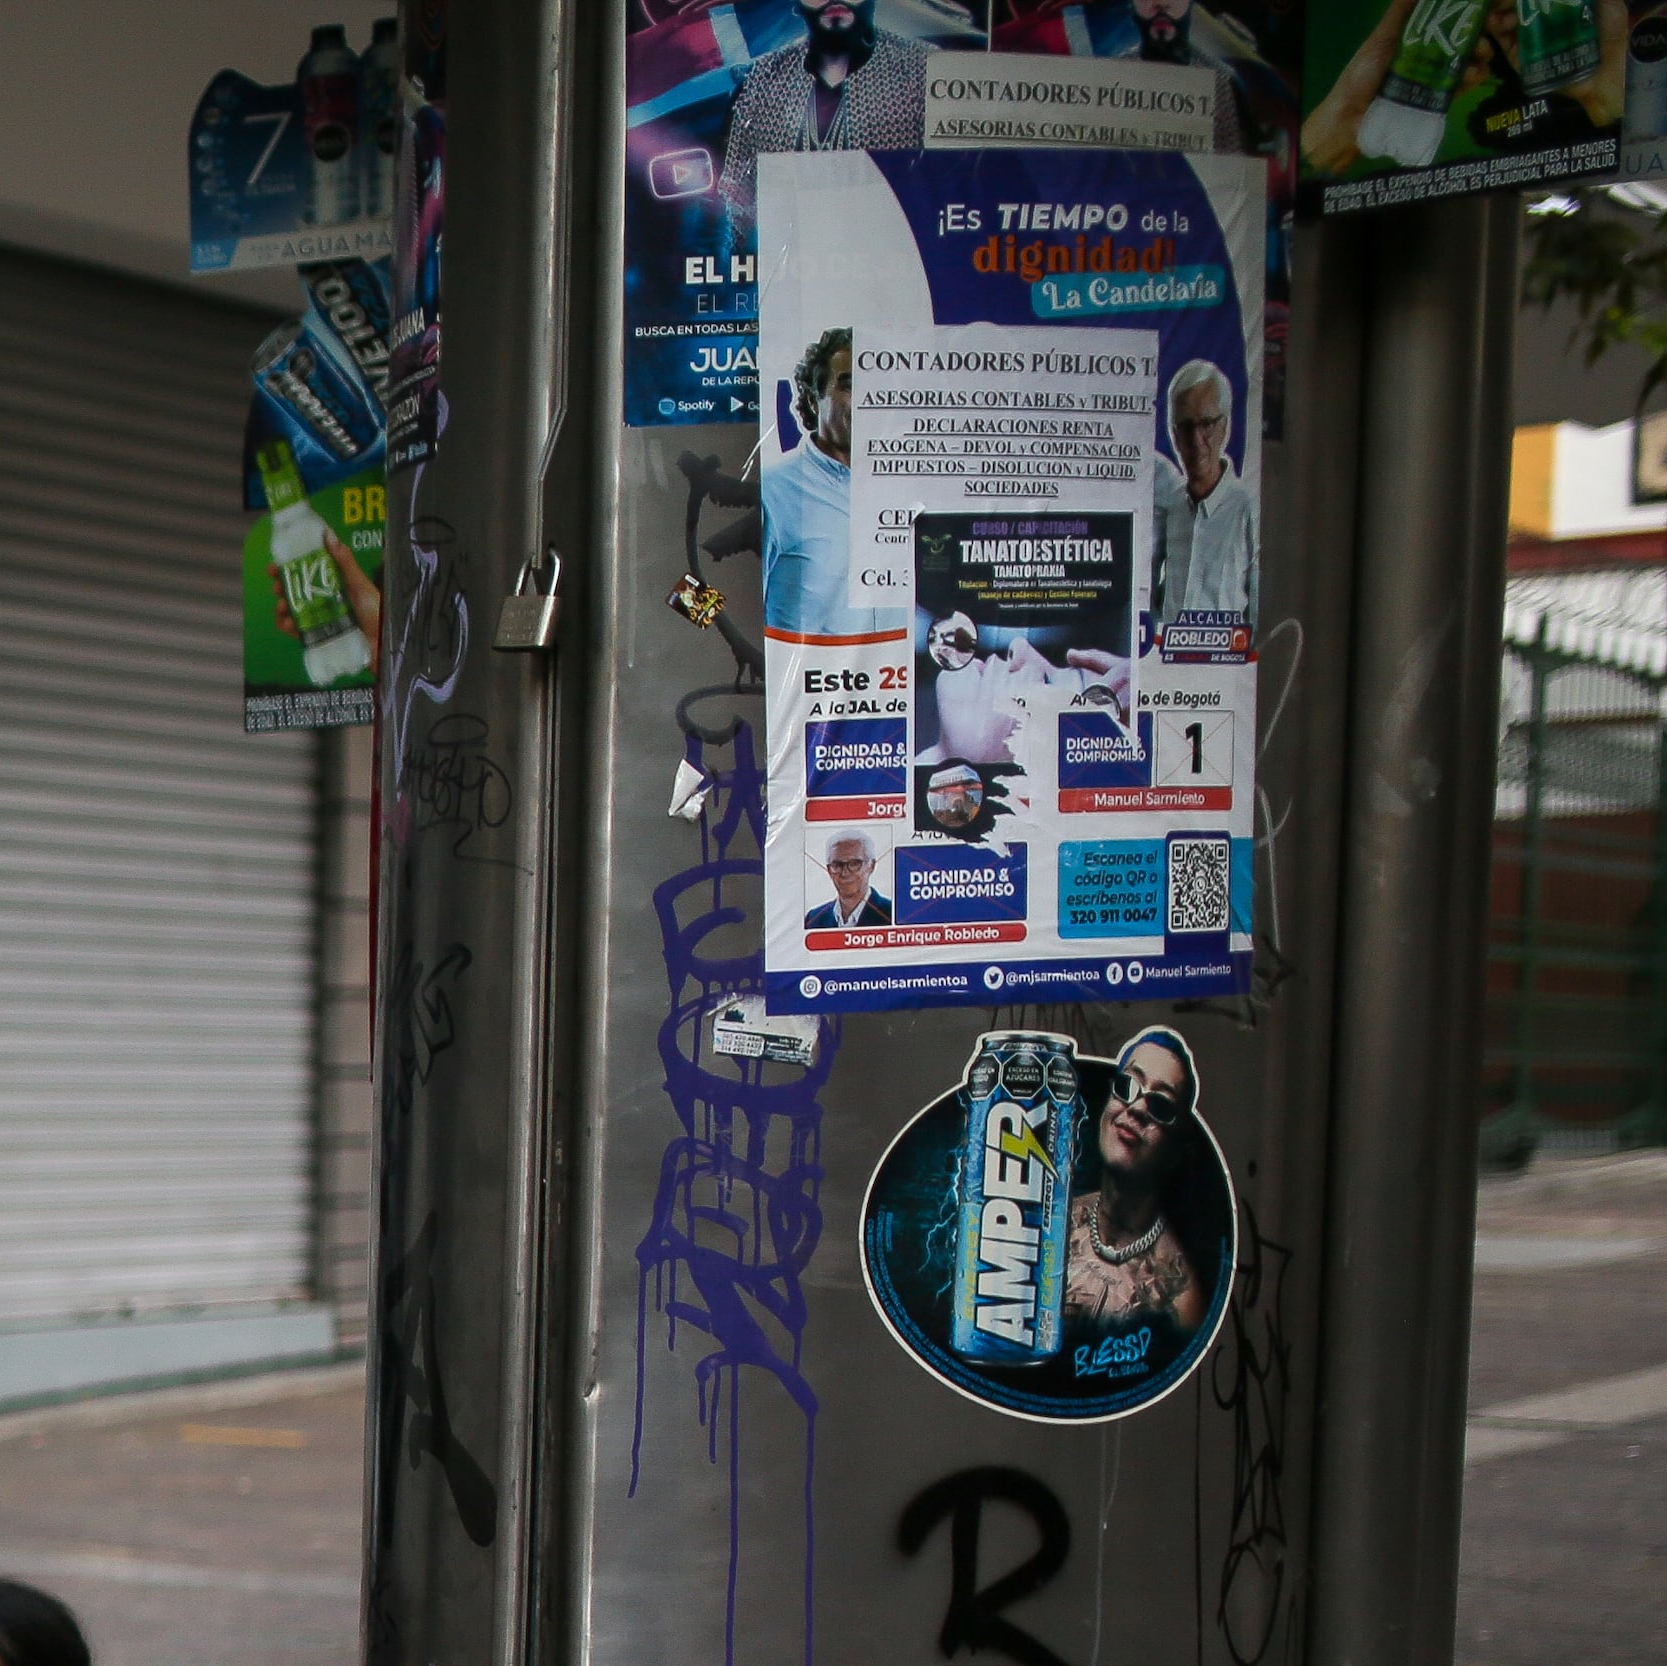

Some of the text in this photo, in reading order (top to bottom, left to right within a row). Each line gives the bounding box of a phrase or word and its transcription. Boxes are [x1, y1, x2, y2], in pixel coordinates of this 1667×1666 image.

[930, 79, 1091, 105] CONTADORES
[1097, 81, 1195, 115] PÚBLICOS
[1486, 100, 1548, 133] NUEVA LATA
[934, 120, 1037, 138] ASESORIAS
[1039, 122, 1140, 147] CONTABLES
[244, 112, 293, 184] 7
[1489, 149, 1561, 173] EMBRIAGANTES
[1562, 147, 1569, 161] A
[1571, 139, 1616, 158] MENORES
[1428, 180, 1467, 197] ALCOHOL
[1470, 177, 1482, 191] ES
[1484, 166, 1542, 188] PERJUDICIAL
[1544, 161, 1568, 178] PARA
[1571, 157, 1582, 172] LA
[1584, 152, 1617, 171] SALUD.
[938, 204, 1189, 236] ¡Es TIEMPO de la
[282, 232, 350, 258] AGUA
[686, 256, 723, 285] EL
[697, 293, 723, 314] EL
[1041, 281, 1083, 311] La
[635, 326, 675, 337] BUSCA
[677, 325, 693, 335] EN
[694, 323, 734, 335] TODAS
[857, 351, 1025, 373] CONTADORES
[1031, 348, 1136, 376] PÚBLICOS
[702, 377, 715, 386] DE
[718, 377, 732, 385] LA
[678, 399, 714, 413] Spotify
[862, 391, 968, 406] ASESORIAS
[971, 391, 1075, 408] CONTABLES
[1091, 394, 1152, 411] TRIBUT.
[913, 418, 1113, 437] DECLARACIONES RENTA
[868, 440, 947, 454] EXOGENA
[963, 441, 1016, 455] DEVOL
[1031, 441, 1141, 459] COMPENSACION
[873, 459, 966, 474] IMPUESTOS
[981, 460, 1072, 476] DISOLUCION
[1086, 463, 1136, 479] LIQUID.
[964, 480, 1059, 495] SOCIEDADES
[973, 521, 1008, 535] CURSO
[959, 535, 1114, 563] TANATOESTÉTICA
[861, 569, 897, 587] Cel.
[994, 564, 1065, 578] TANATOPRAXIA
[1178, 613, 1240, 625] ALCALDE
[1169, 631, 1229, 645] ROBLEDO
[804, 669, 870, 693] Este
[810, 699, 907, 716] A la JAL de
[1152, 690, 1170, 705] de
[1174, 689, 1221, 709] Bogotá
[815, 743, 906, 759] DIGNIDAD &
[1066, 737, 1133, 750] DIGNIDAD
[1185, 722, 1202, 774] 1
[1066, 750, 1146, 763] COMPROMISO
[1095, 790, 1206, 807] Manuel Sarmiento
[1083, 851, 1158, 866] Escanea el
[910, 867, 1009, 886] DIGNIDAD &
[1074, 870, 1158, 889] código QR o
[910, 882, 1015, 900] COMPROMISO
[1067, 889, 1157, 907] escríbenos al
[1070, 908, 1158, 925] 320 911 0047
[844, 926, 1000, 949] Jorge Enrique Robledo
[824, 962, 1231, 996] @manuelsarmientoa @mjsarmientoa Manuel Sarmiento
[1047, 1110, 1057, 1153] DRINK
[1043, 1172, 1054, 1229] ENERGY
[975, 1101, 1049, 1347] AMPER
